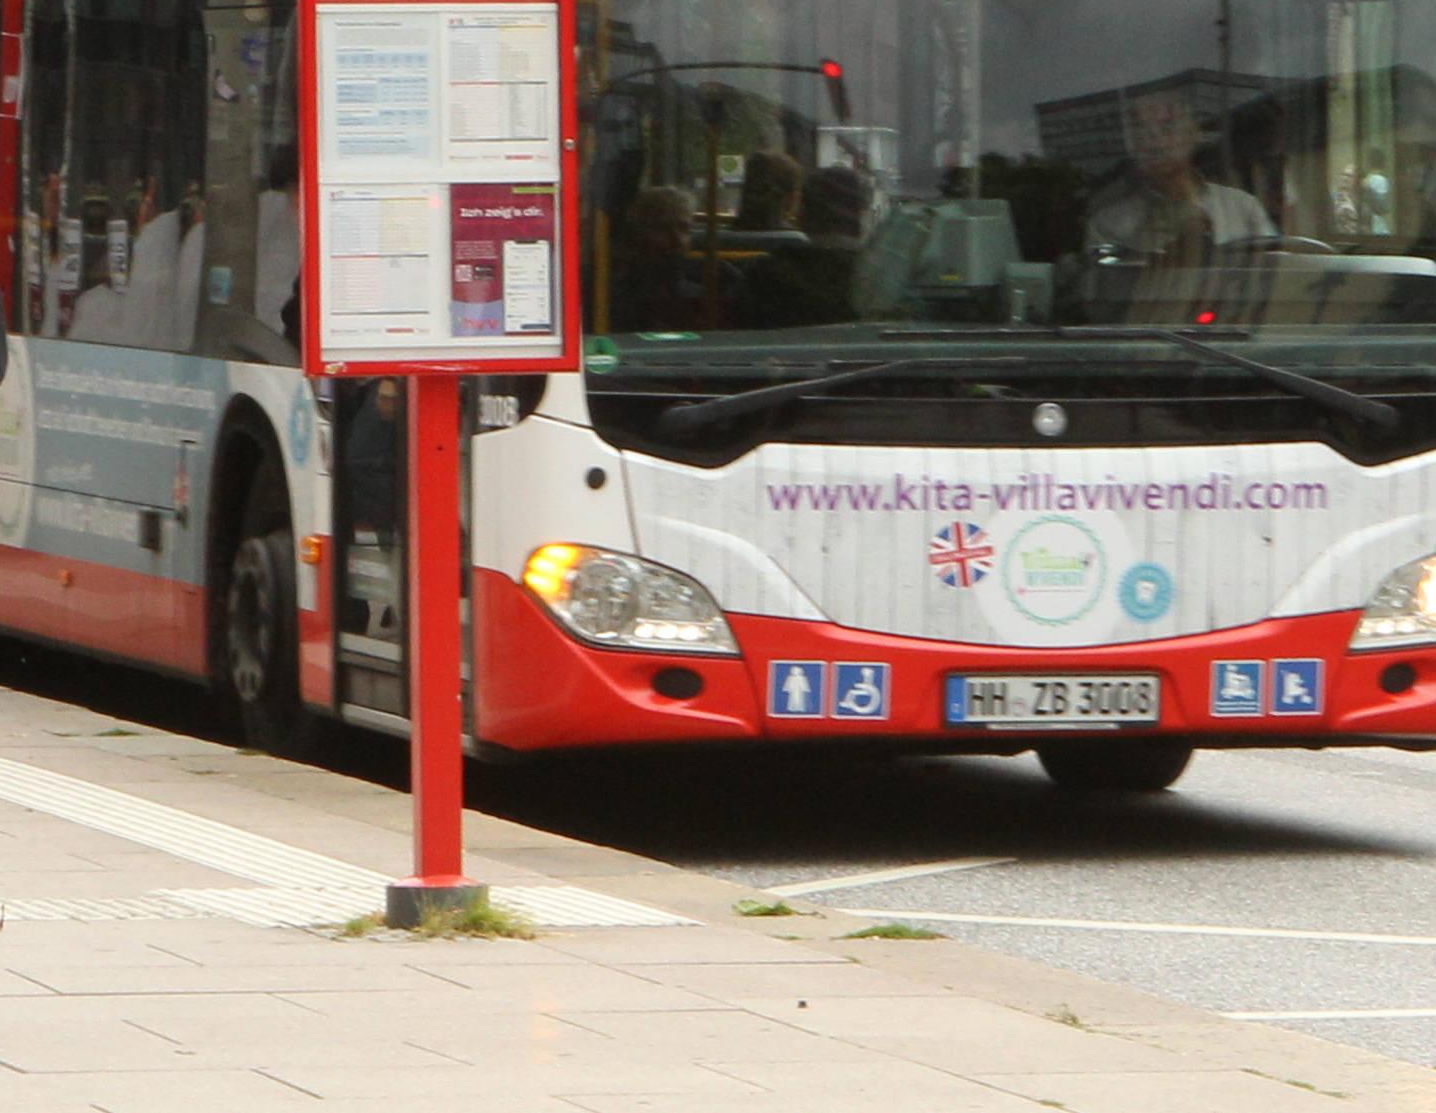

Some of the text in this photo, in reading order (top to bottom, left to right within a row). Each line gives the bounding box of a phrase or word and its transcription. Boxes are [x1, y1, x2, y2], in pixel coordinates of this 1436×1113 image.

[766, 473, 1329, 511] www.kita-villavivendi.com
[968, 681, 1151, 717] HH ZB 3008
